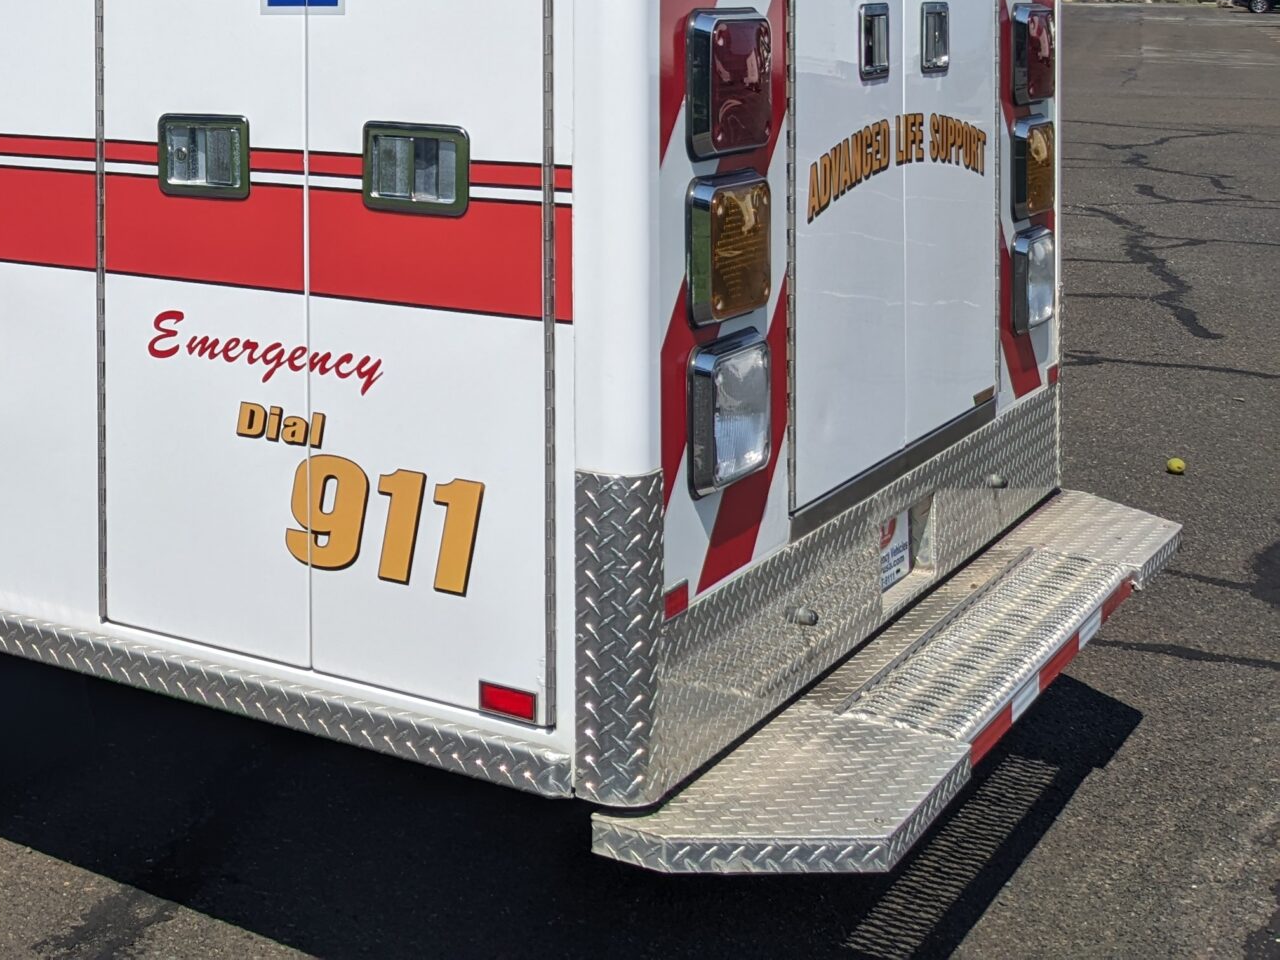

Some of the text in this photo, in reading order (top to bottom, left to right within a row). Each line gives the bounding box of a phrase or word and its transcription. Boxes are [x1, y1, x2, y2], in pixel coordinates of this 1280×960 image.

[807, 113, 987, 224] ADVANCED LIFE SUPPORT
[147, 310, 383, 396] Emergency
[236, 401, 327, 450] Dial
[285, 454, 486, 597] 911
